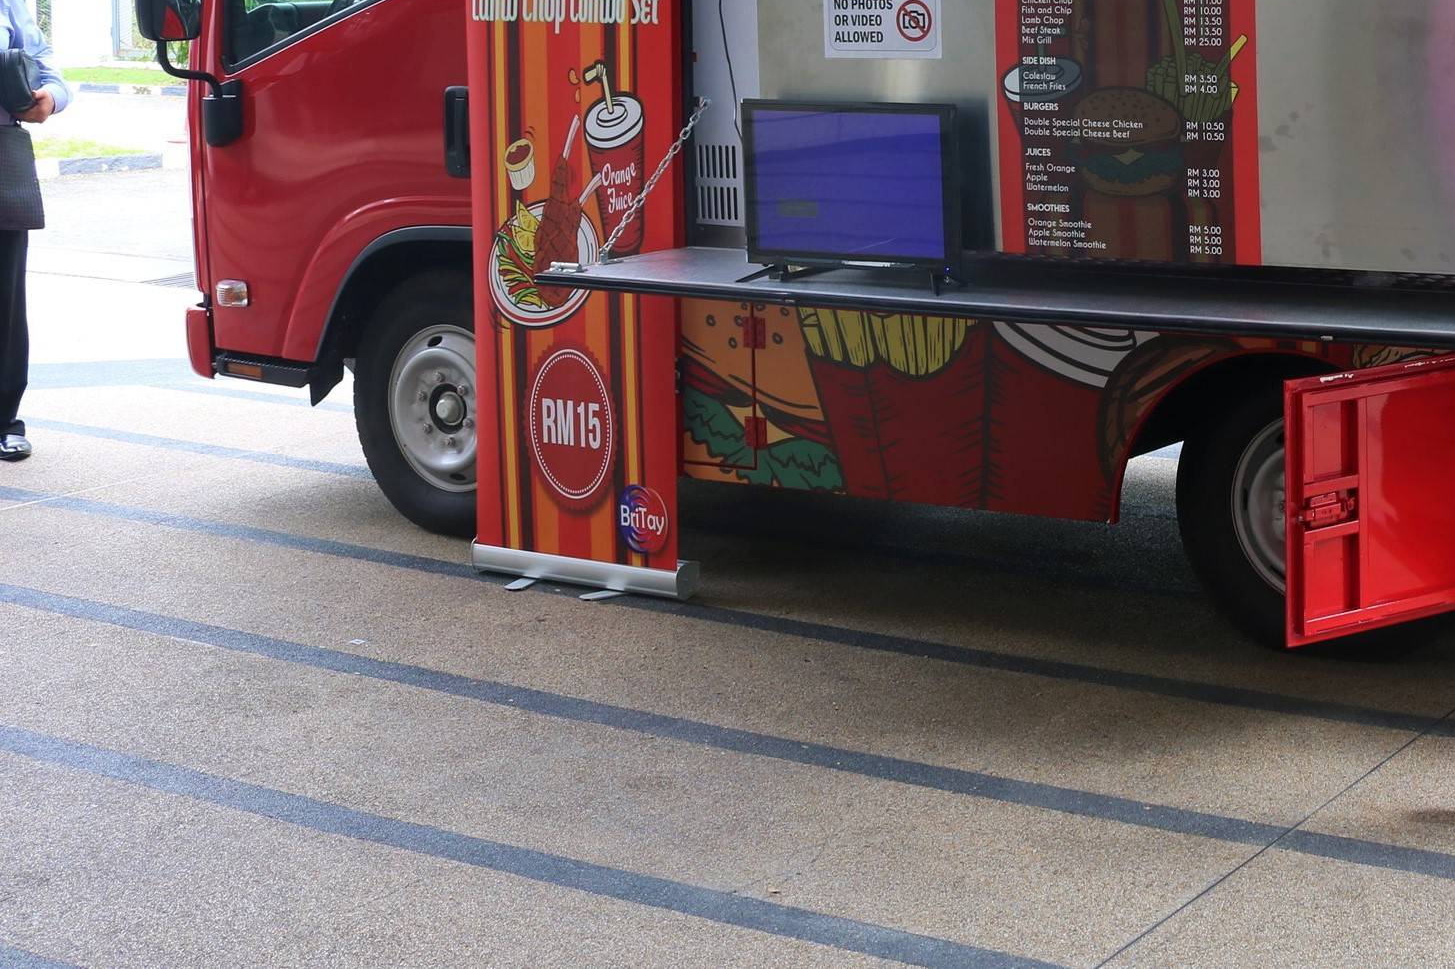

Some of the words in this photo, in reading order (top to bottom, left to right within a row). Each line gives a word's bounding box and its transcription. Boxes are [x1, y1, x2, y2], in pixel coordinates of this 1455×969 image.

[1021, 6, 1035, 14] Fish
[1037, 6, 1052, 14] and
[1054, 6, 1072, 16] Chip
[1184, 6, 1196, 15] RM
[1200, 6, 1222, 15] 10.00
[834, 14, 848, 26] OR
[850, 14, 882, 26] VIDEO
[1022, 16, 1041, 24] Lamb
[1043, 16, 1064, 25] Chop
[1184, 16, 1196, 25] RM
[1200, 16, 1222, 25] 13.50
[1022, 26, 1038, 34] Beef
[1040, 26, 1061, 34] Steak
[1184, 27, 1196, 36] RM
[1200, 27, 1222, 36] 13.50
[834, 30, 884, 43] ALLOWED
[1022, 36, 1035, 44] Mix
[1036, 36, 1052, 44] Grill
[1184, 38, 1196, 46] RM
[1199, 38, 1222, 46] 25.00
[1022, 56, 1038, 65] SIDE
[1040, 56, 1056, 65] DISH
[1022, 72, 1056, 80] Coleslaw
[1184, 74, 1196, 83] RM
[1200, 74, 1218, 83] 3.50
[1023, 82, 1048, 90] French
[1049, 82, 1066, 90] Fries
[1184, 85, 1197, 94] RM
[1200, 85, 1218, 94] 4.00
[1024, 102, 1059, 110] BURGERS
[1024, 117, 1050, 126] Double
[1052, 118, 1080, 128] Special
[1082, 118, 1110, 128] Cheese
[1112, 120, 1143, 129] Chicken
[1186, 122, 1198, 130] RM
[1202, 122, 1224, 130] 10.50
[1024, 127, 1050, 136] Double
[1052, 128, 1080, 138] Special
[1082, 128, 1110, 138] Cheese
[1112, 130, 1130, 138] Beef
[1186, 132, 1198, 140] RM
[1202, 132, 1224, 141] 10.50
[1025, 148, 1052, 156] JUICES
[1025, 162, 1044, 171] Fresh
[1046, 163, 1076, 174] Orange
[602, 162, 636, 186] Orange
[1026, 172, 1048, 182] Apple
[1187, 168, 1200, 177] RM
[1202, 168, 1220, 178] 3.00
[1026, 182, 1069, 192] Watermelon
[1187, 178, 1200, 188] RM
[1202, 179, 1220, 188] 3.00
[1188, 189, 1200, 198] RM
[1202, 189, 1220, 198] 3.00
[607, 188, 634, 214] Juice
[1026, 202, 1070, 212] SMOOTHIES
[1028, 218, 1057, 228] Orange
[1058, 219, 1092, 228] Smoothie
[1028, 228, 1050, 238] Apple
[1052, 229, 1086, 238] Smoothie
[1189, 225, 1201, 234] RM
[1204, 226, 1222, 234] 5.00
[1028, 237, 1072, 248] Watermelon
[1073, 240, 1107, 249] Smoothie
[1190, 235, 1202, 244] RM
[1204, 236, 1222, 244] 5.00
[1190, 246, 1202, 254] RM
[1204, 246, 1222, 255] 5.00
[620, 504, 664, 536] BriTay
